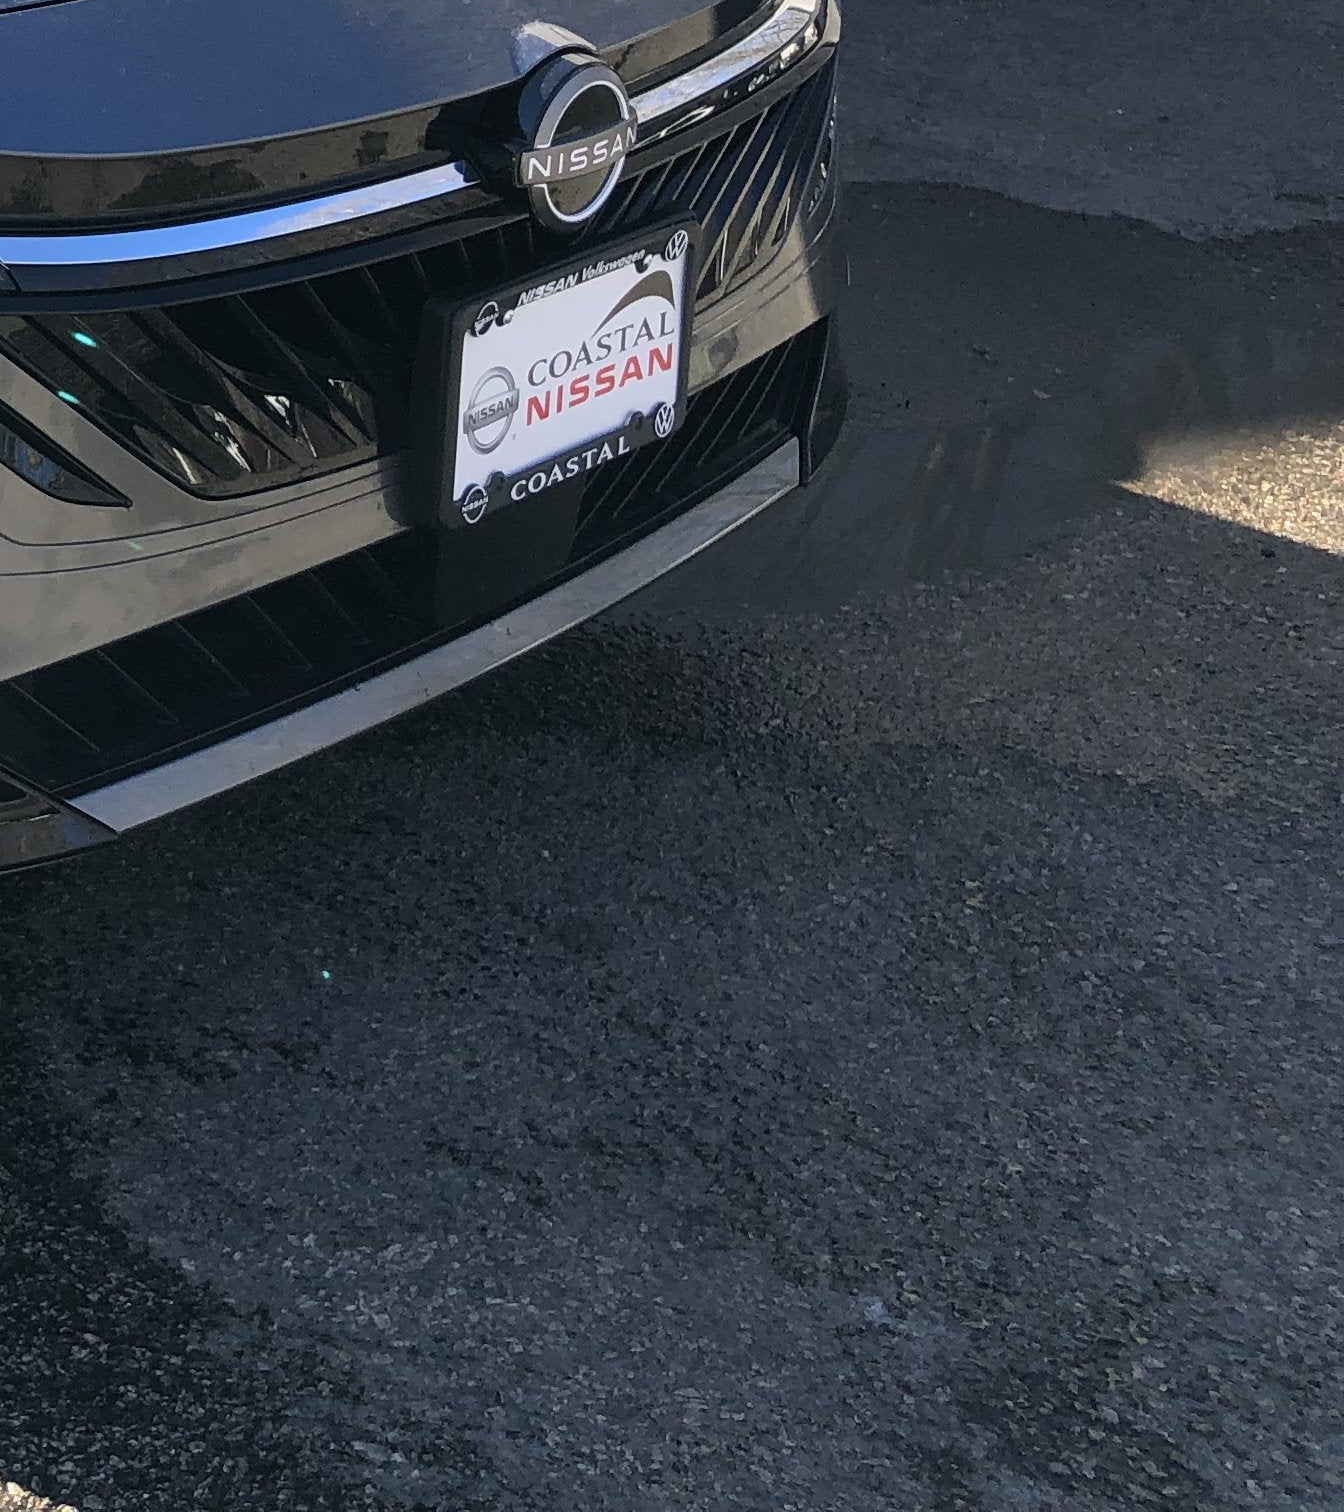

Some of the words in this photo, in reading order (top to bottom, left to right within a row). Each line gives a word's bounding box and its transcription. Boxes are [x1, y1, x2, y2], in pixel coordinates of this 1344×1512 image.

[527, 126, 637, 180] NISSAN
[517, 272, 578, 307] NISSAN
[581, 249, 646, 281] Volkswagen
[527, 312, 675, 387] COASTAL
[468, 396, 514, 425] NISSAN
[526, 342, 673, 426] NISSAN
[510, 436, 630, 501] COASTAL
